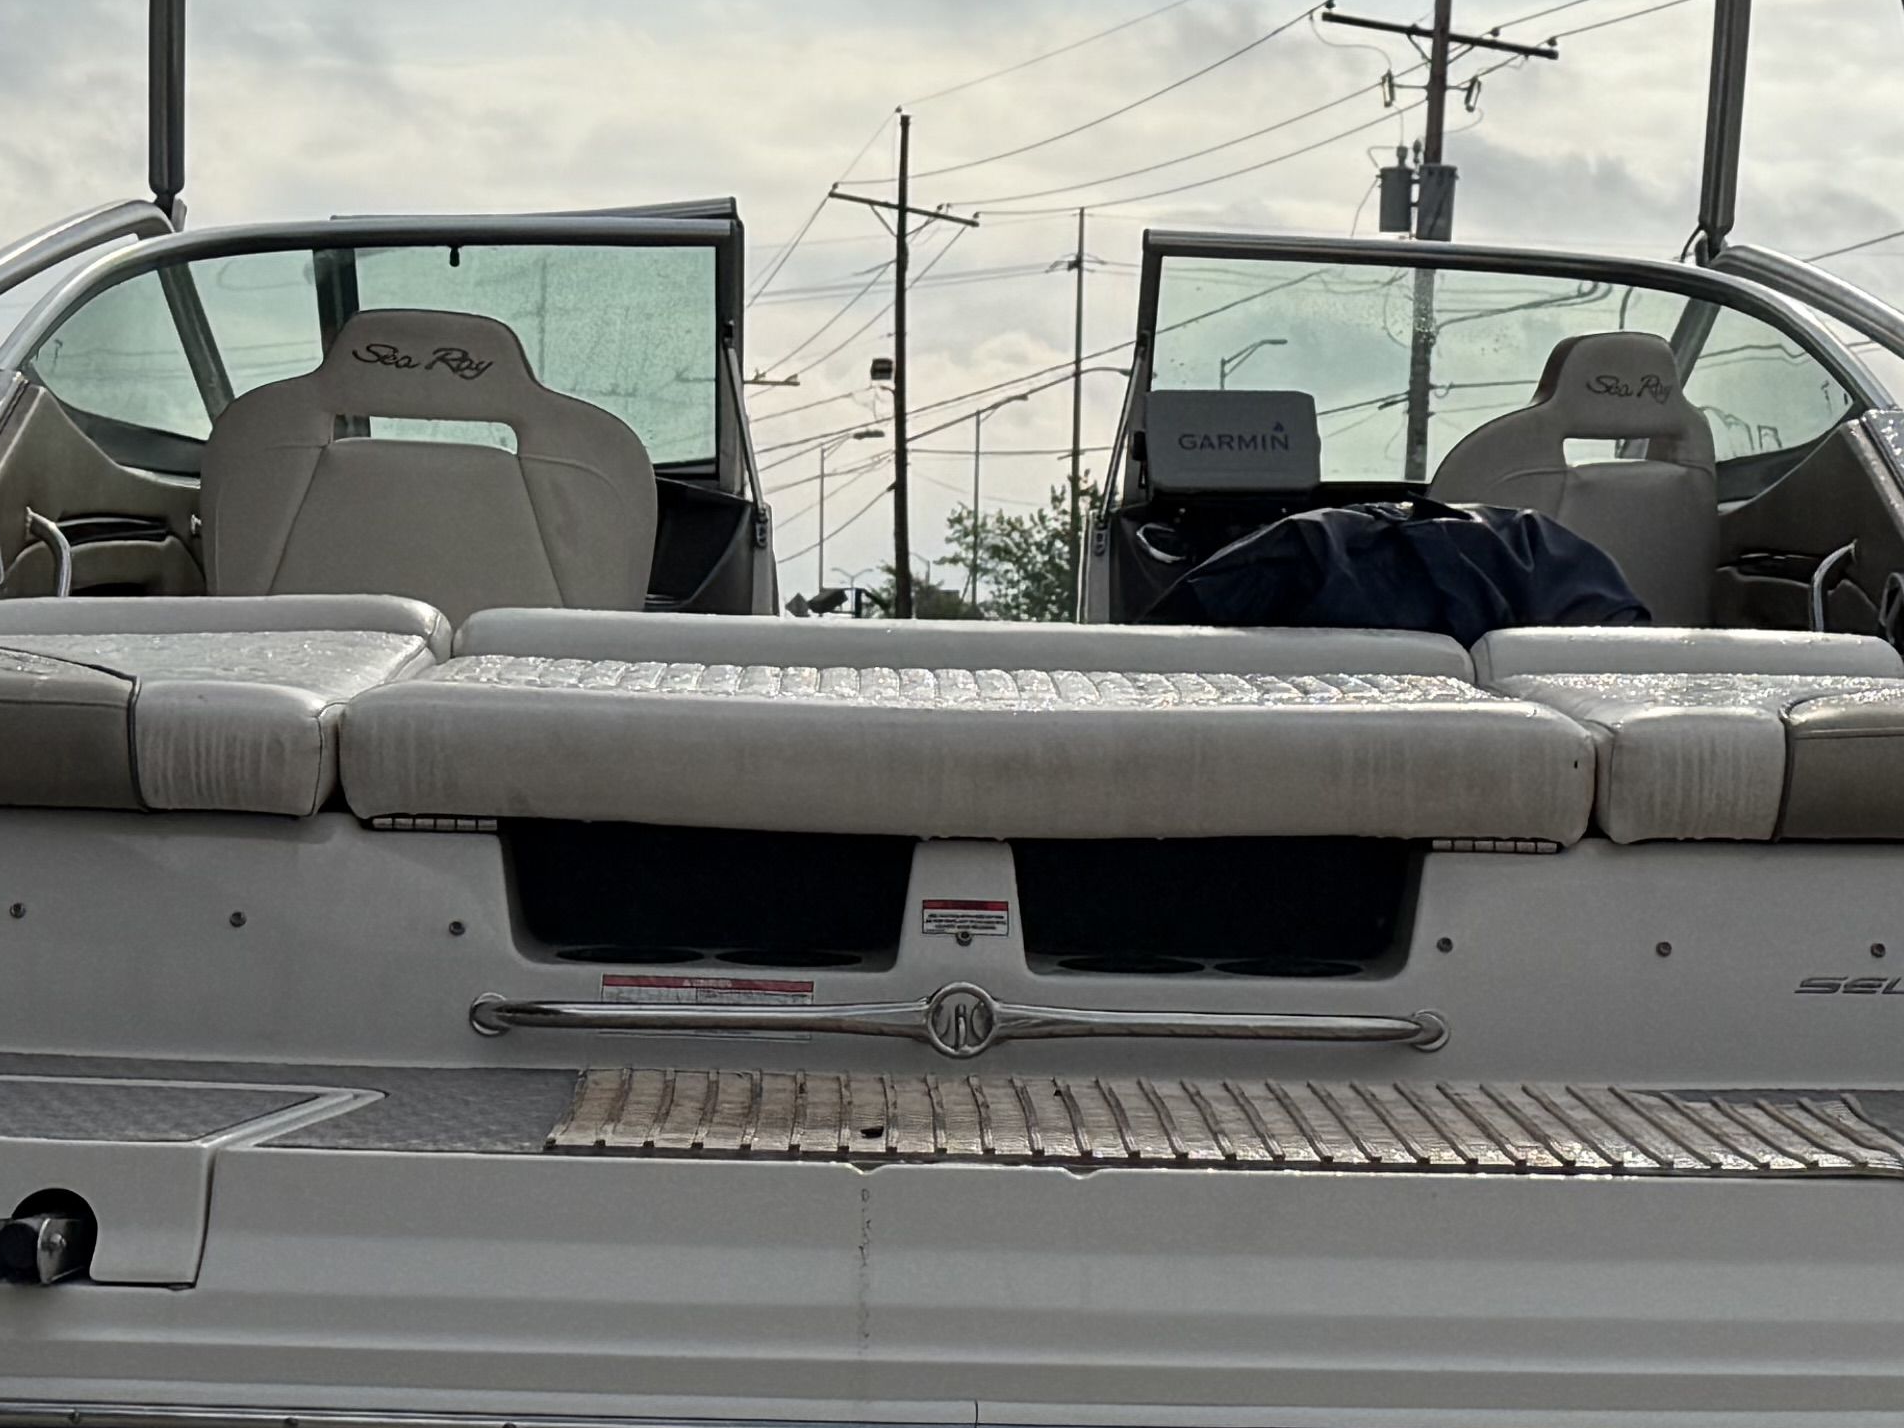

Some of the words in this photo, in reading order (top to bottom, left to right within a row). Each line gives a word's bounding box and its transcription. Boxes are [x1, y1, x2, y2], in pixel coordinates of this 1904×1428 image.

[352, 343, 421, 369] Sea
[424, 347, 493, 380] Ray
[1585, 374, 1634, 398] Sea
[1178, 433, 1289, 451] GARMIN
